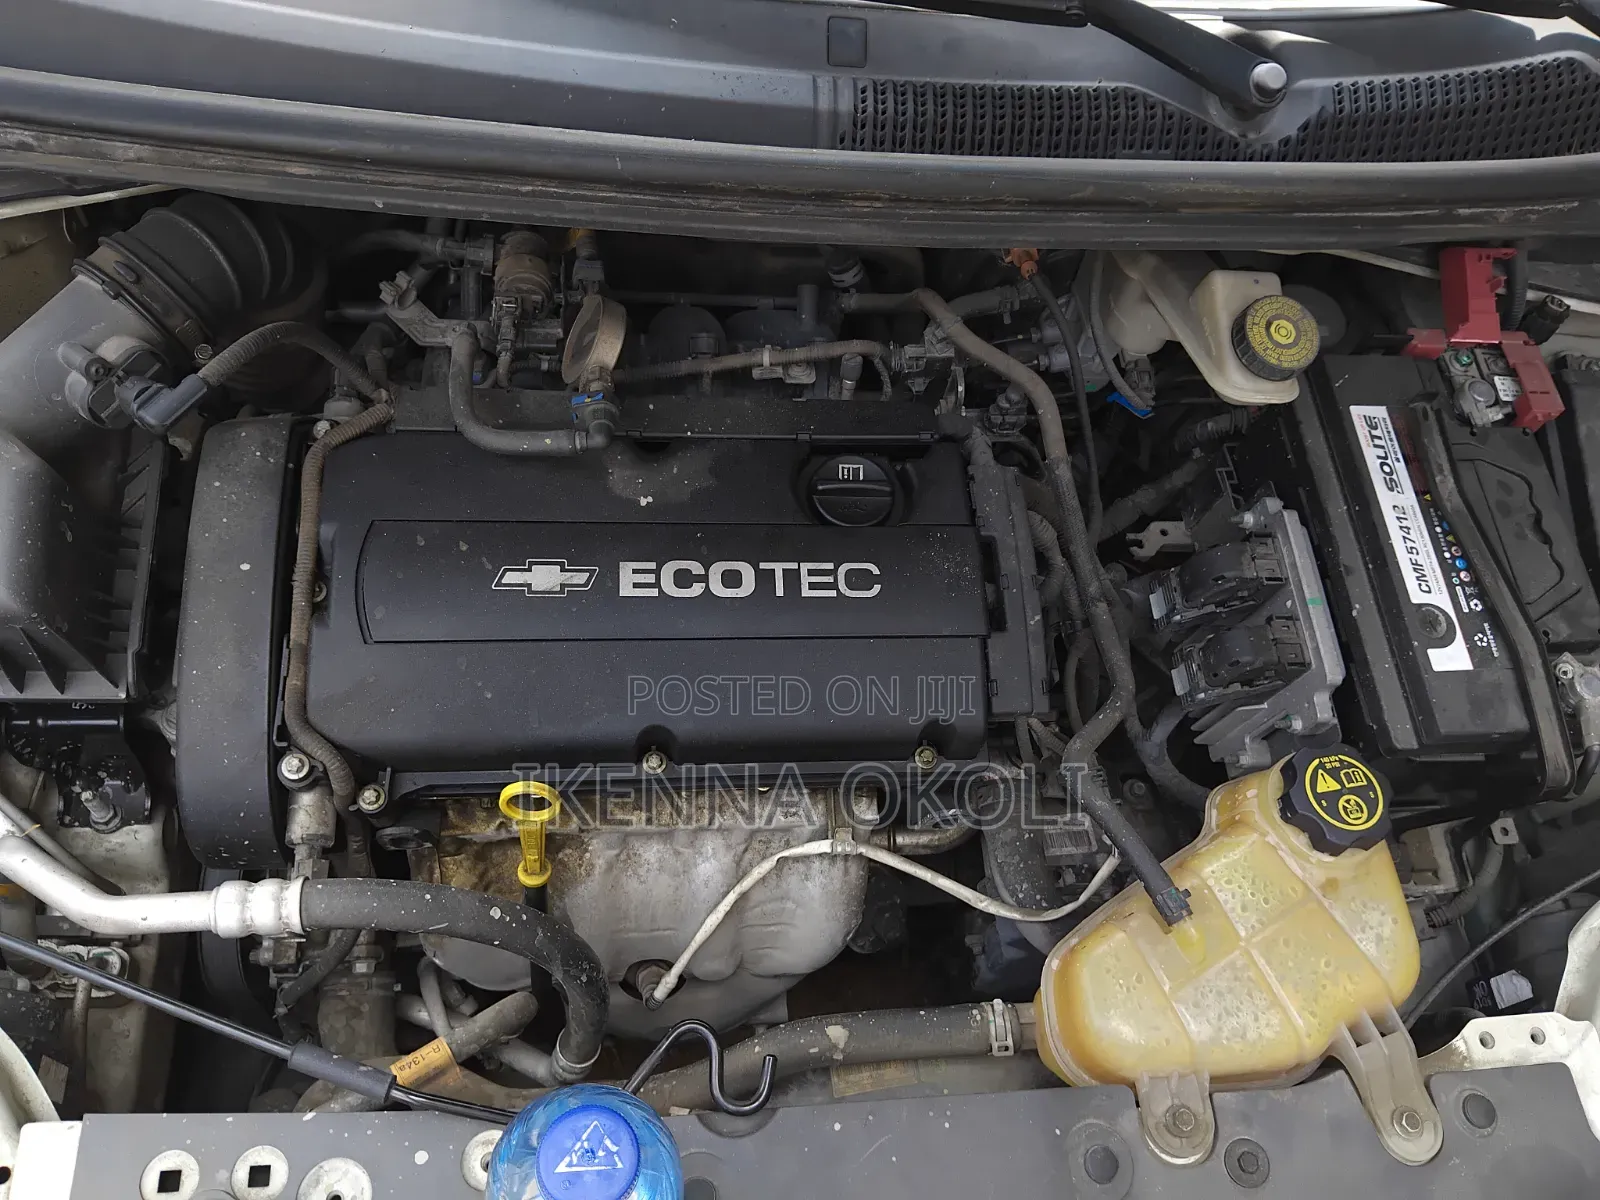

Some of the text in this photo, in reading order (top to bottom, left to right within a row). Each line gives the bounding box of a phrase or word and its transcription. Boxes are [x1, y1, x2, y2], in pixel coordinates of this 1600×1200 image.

[1363, 413, 1399, 494] SOLITE
[619, 560, 881, 598] ECOTEC
[398, 1044, 441, 1072] R-134a
